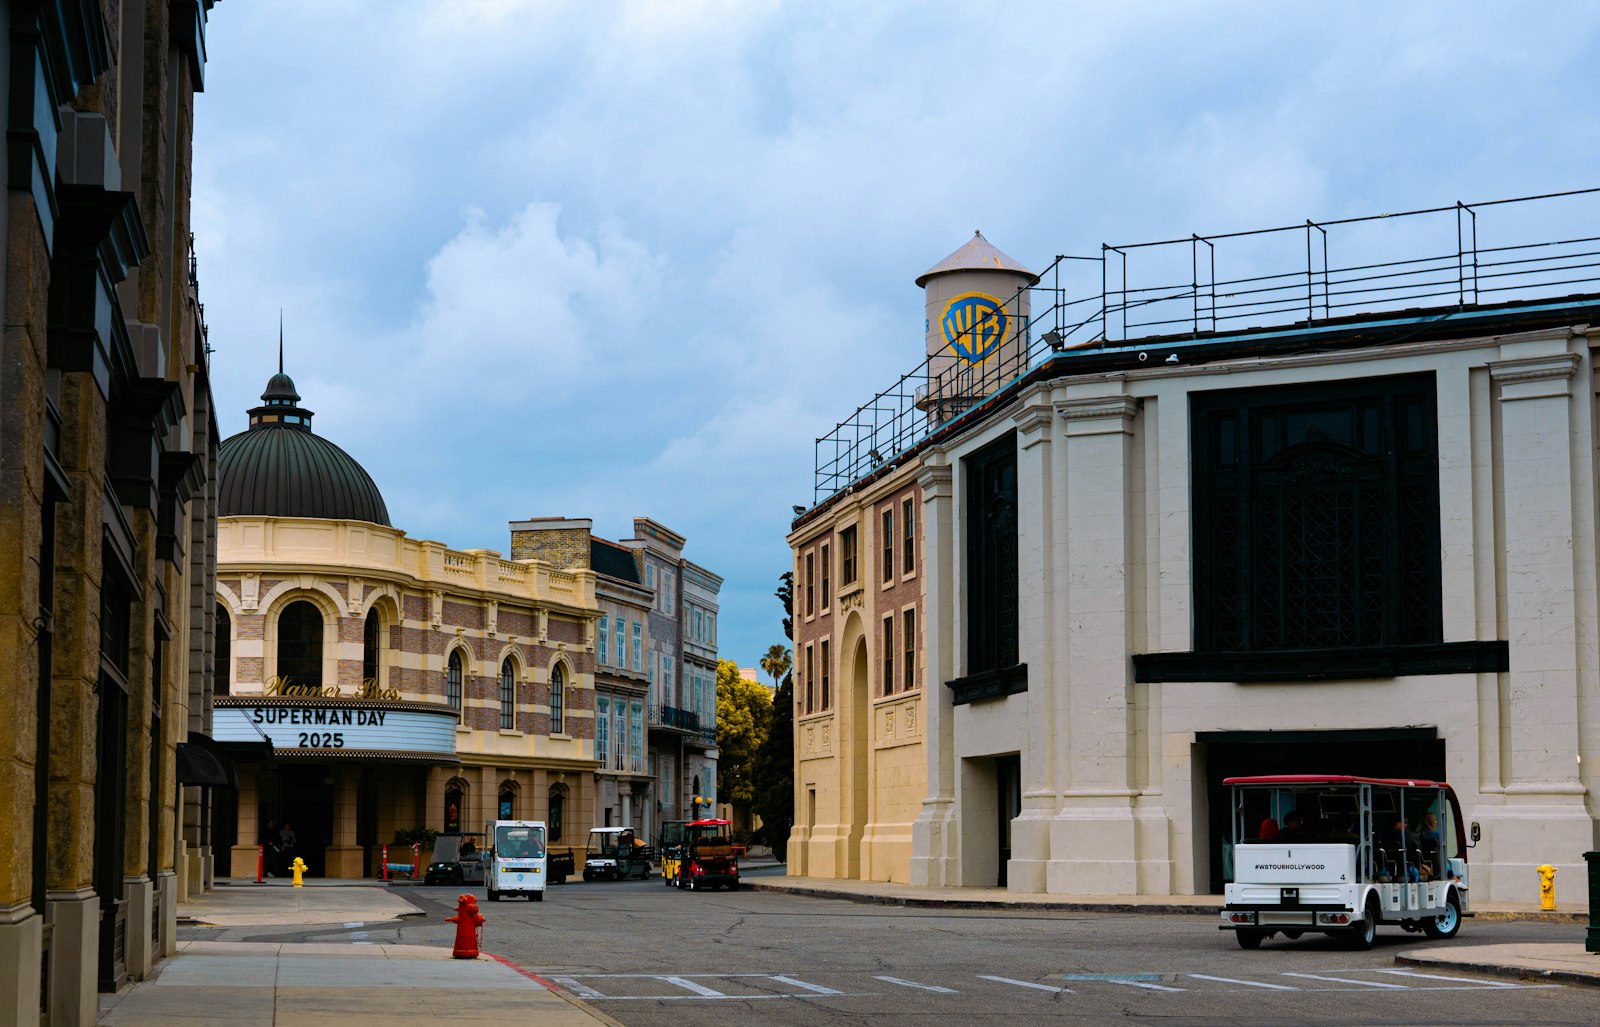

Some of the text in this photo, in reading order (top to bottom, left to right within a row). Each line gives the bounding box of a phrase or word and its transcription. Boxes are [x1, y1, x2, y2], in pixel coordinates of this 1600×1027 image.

[947, 304, 1000, 355] WB
[264, 675, 402, 700] Warner Bros.
[254, 708, 386, 726] SUPERMAN DAY
[299, 732, 344, 748] 2025
